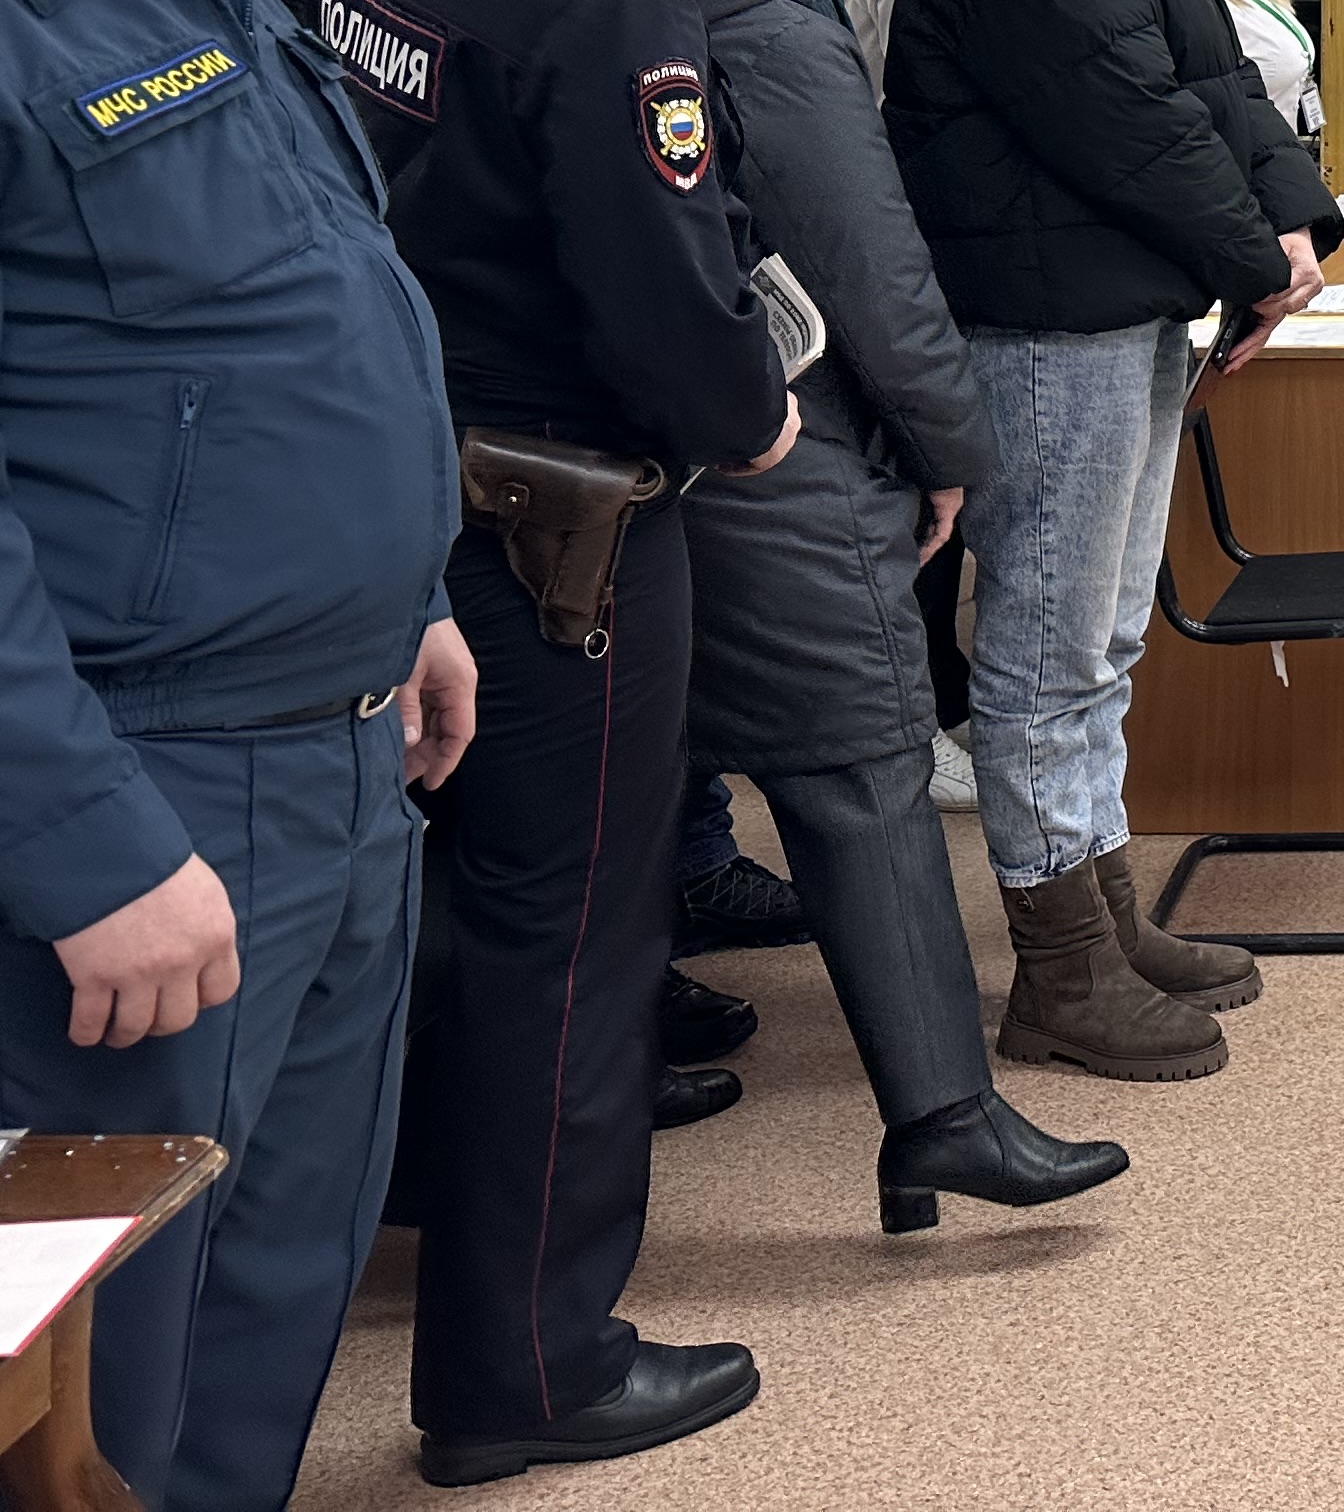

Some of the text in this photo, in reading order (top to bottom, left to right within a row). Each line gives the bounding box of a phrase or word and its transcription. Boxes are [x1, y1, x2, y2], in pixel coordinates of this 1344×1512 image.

[86, 49, 237, 128] МЧС РОССИИ
[675, 172, 698, 190] МВД
